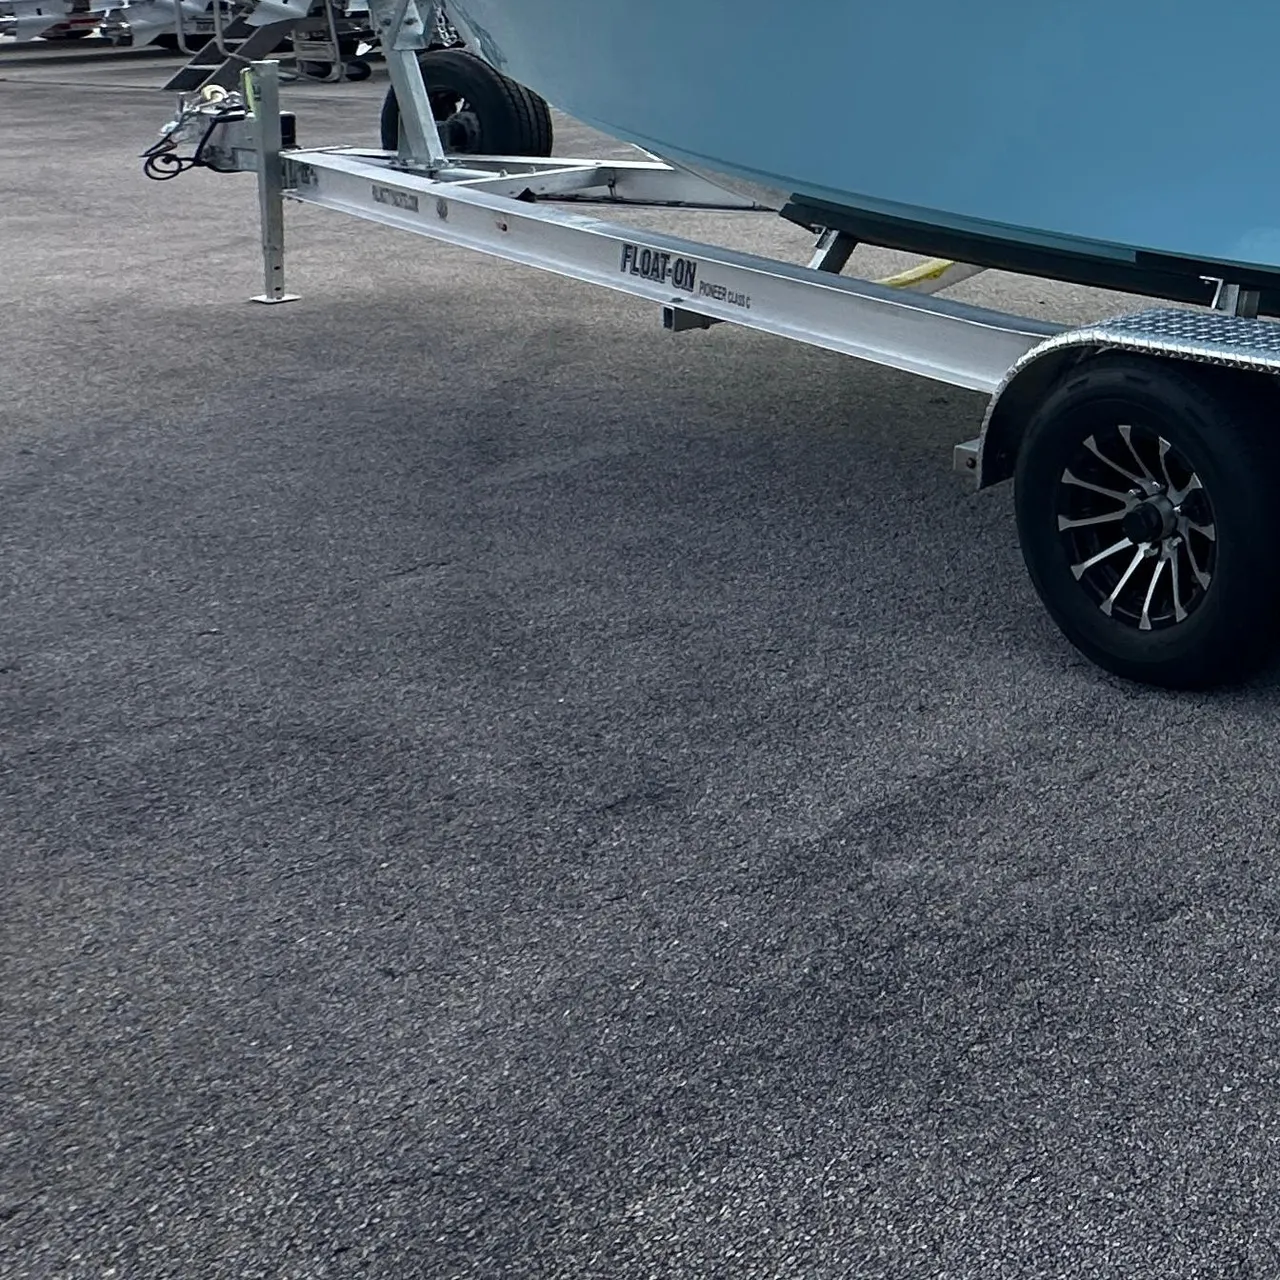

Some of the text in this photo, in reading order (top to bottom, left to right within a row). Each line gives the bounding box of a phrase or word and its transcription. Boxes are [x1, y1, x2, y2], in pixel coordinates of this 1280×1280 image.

[620, 243, 698, 292] FLOAT-ON
[700, 281, 727, 302] PIONEER
[728, 291, 745, 307] CLASS
